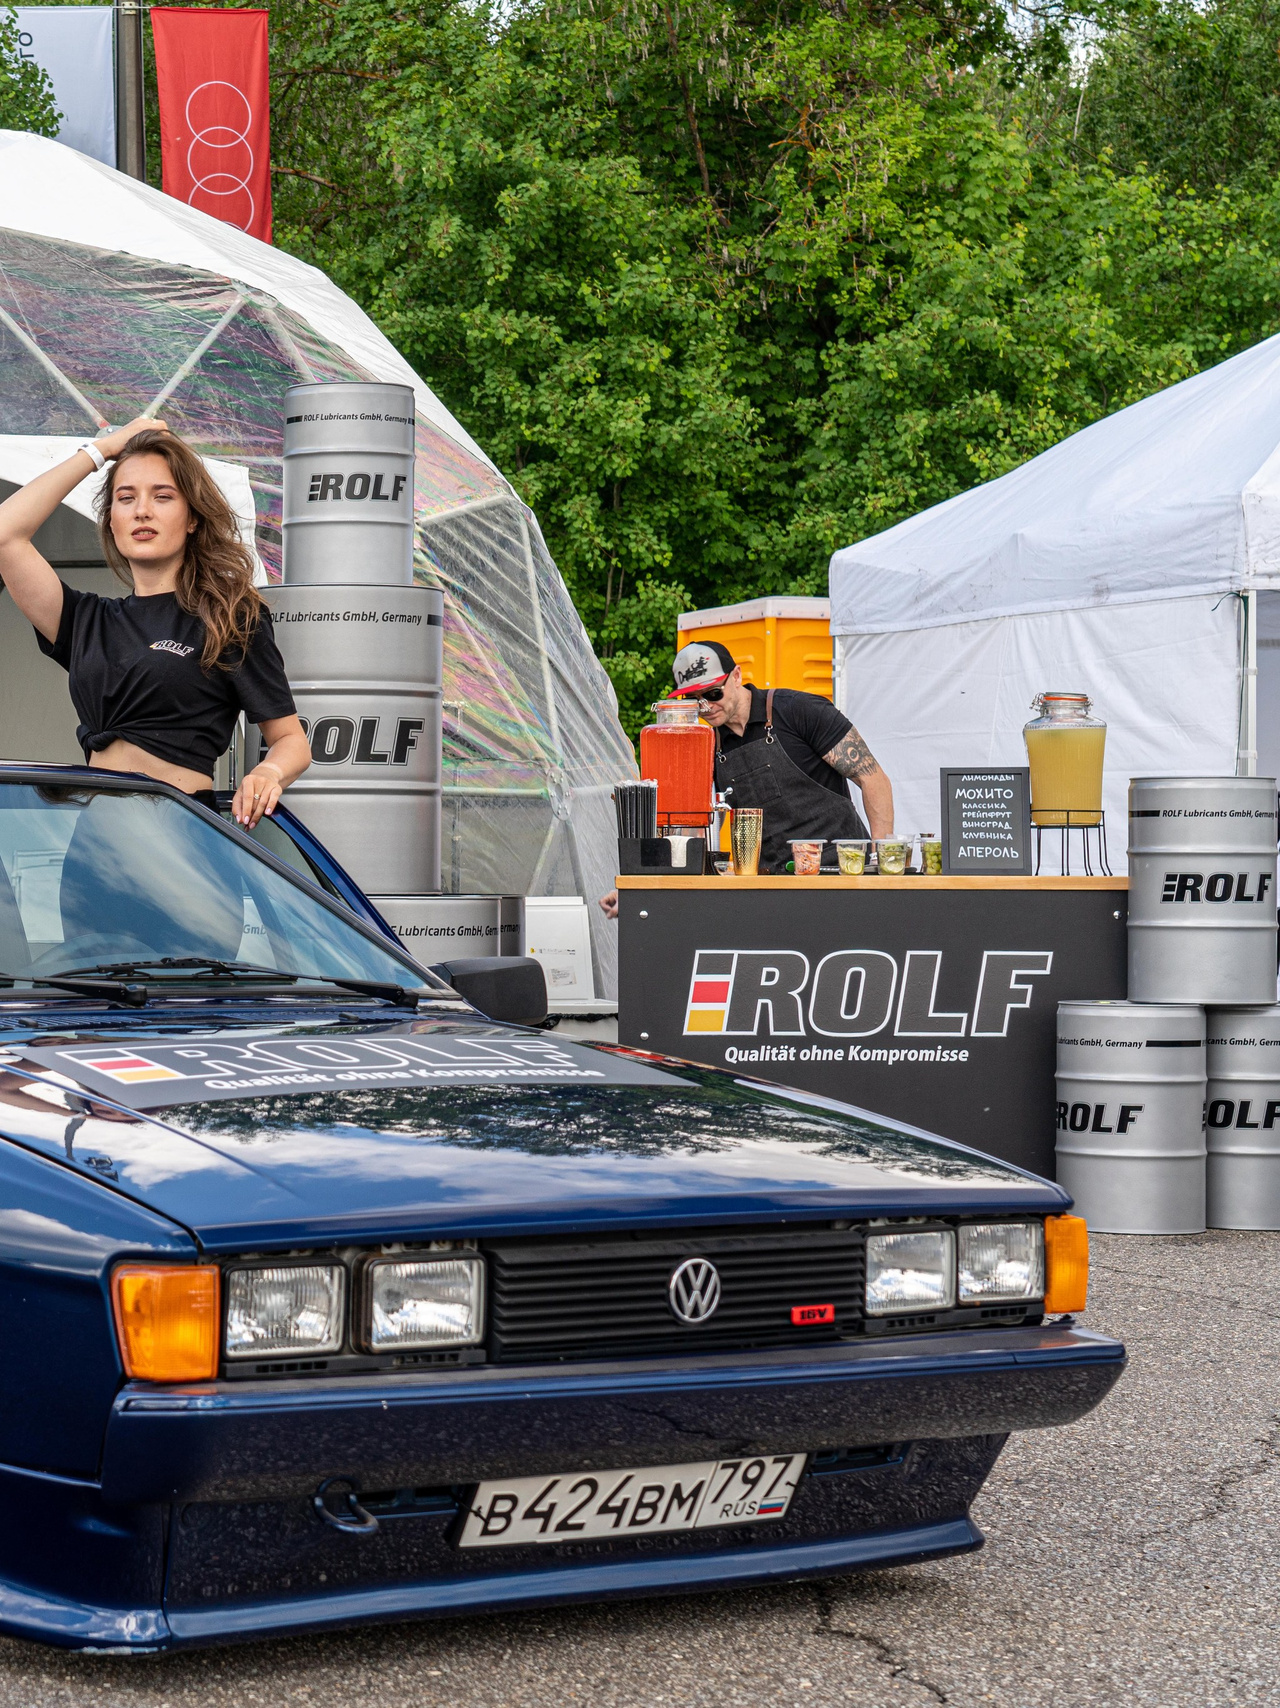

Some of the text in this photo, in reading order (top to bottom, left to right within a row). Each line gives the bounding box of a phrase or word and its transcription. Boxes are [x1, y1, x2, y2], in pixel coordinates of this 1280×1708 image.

[304, 412, 408, 425] ROLF Lubricants GmbH, Germany
[317, 473, 407, 502] ROLF
[270, 611, 422, 626] OLF Lubricants GmbH, Germany
[298, 716, 425, 766] OLF
[955, 788, 1014, 800] МОХИТО
[962, 810, 1012, 819] ГРЕЙПФРУТ
[1162, 809, 1275, 820] ROLF Lubricants GmbH, Germany
[962, 821, 1012, 830] ВИНОГРАД
[962, 831, 1013, 840] КЛУБНИКА
[958, 846, 1019, 859] АПЕРОЛЬ
[1174, 872, 1272, 904] ROLF
[398, 925, 455, 937] Lubricants
[457, 925, 484, 938] GmbH,
[726, 949, 1054, 1037] ROLF
[1079, 1038, 1104, 1048] GmbH,
[1105, 1039, 1143, 1049] Germany
[1229, 1037, 1257, 1047] GmbH,
[120, 1039, 578, 1078] ROLF
[725, 1043, 969, 1065] Qualität ohne Kompromisse
[204, 1067, 606, 1090] Qualität ohne Kompromisse
[1057, 1101, 1145, 1135] ROLF
[1207, 1098, 1280, 1131] OLF
[800, 1308, 827, 1321] 16V
[711, 1456, 795, 1506] 797
[719, 1500, 758, 1519] RUS
